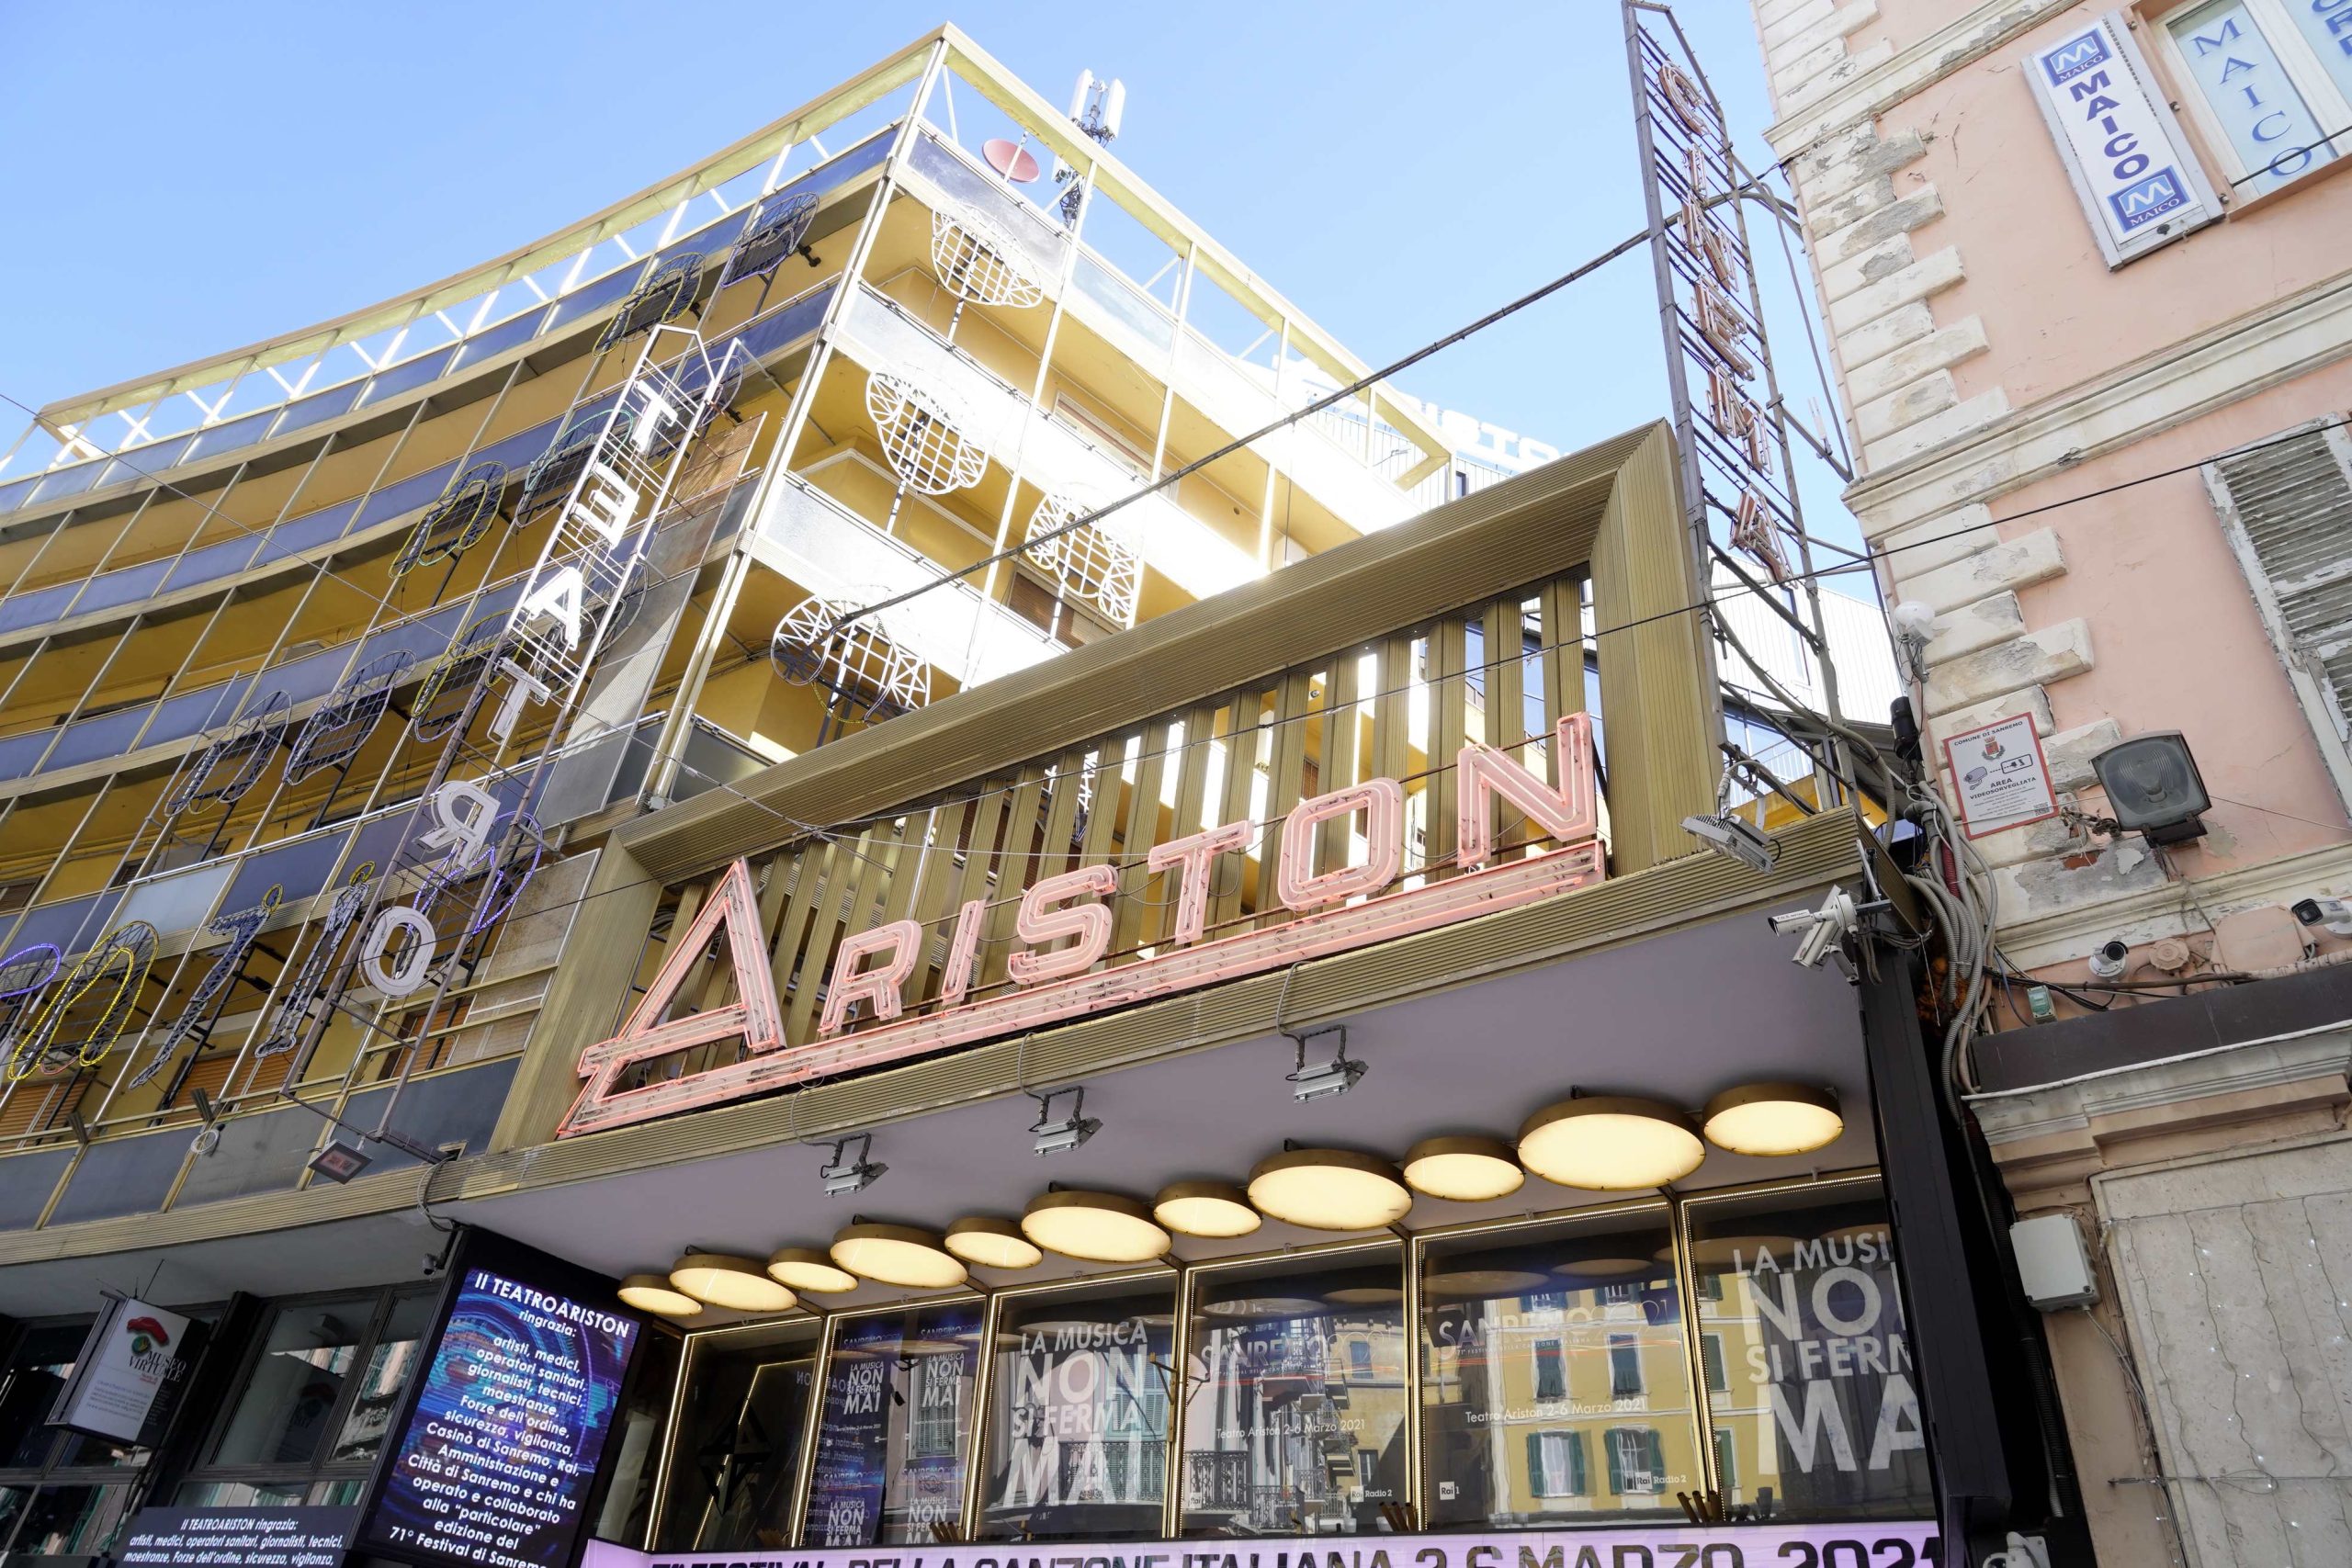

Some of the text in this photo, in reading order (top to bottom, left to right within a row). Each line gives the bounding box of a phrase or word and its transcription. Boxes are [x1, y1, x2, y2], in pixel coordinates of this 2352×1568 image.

[2058, 53, 2104, 83] MAICO
[2192, 16, 2312, 177] MAICO
[2069, 69, 2150, 180] MAICO
[2130, 197, 2180, 228] MAICO
[1657, 60, 1798, 589] CINEMA
[1954, 735, 1982, 747] COMUNE
[1992, 721, 2023, 734] SANREMO
[1970, 776, 2037, 800] VIDEOSORVEGLIATA
[1990, 778, 2013, 789] AREA
[558, 711, 1605, 1138] ARISTON
[1733, 1246, 1780, 1278] LA
[475, 1272, 630, 1338] Il TEATROARISTON
[518, 1310, 577, 1337] ringrazia:
[1021, 1320, 1148, 1355] LA MUSICA
[147, 1350, 187, 1372] MUSEO
[493, 1336, 581, 1373] artisti, medici,
[860, 1361, 884, 1370] MUSICA
[938, 1352, 965, 1361] MUSICA
[1746, 1345, 1783, 1384] SI
[128, 1356, 183, 1382] VIRTUALE
[476, 1349, 586, 1392] operatori sanitari,
[848, 1369, 883, 1386] NON
[925, 1376, 962, 1387] SI FERMA
[926, 1359, 965, 1379] NON
[1015, 1344, 1148, 1406] NON
[467, 1364, 584, 1408] giornalisti, tecnici,
[846, 1383, 881, 1395] SI FERMA
[922, 1383, 962, 1408] MAI
[482, 1385, 560, 1417] maestranze,
[843, 1392, 881, 1415] MAI
[1464, 1399, 1646, 1424] Teatro Ariston 2-6 Marzo 2021
[460, 1394, 570, 1438] Forze dell'ordine,
[1012, 1400, 1142, 1438] SI FERMA
[1216, 1419, 1365, 1439] Teatro Ariston 2-6 Marzo 2021
[445, 1410, 573, 1458] sicurezza, vigilanza,
[426, 1422, 580, 1477] Casinò di Sanremo, Rai,
[437, 1444, 560, 1487] Amministrazione e
[1002, 1430, 1142, 1507] MAI
[408, 1454, 577, 1511] Città di Sanremo e chi ha
[1364, 1489, 1387, 1497] Radio
[1441, 1486, 1454, 1496] Rai
[1637, 1475, 1652, 1486] Rai
[1654, 1474, 1680, 1484] Radio
[413, 1476, 560, 1524] operato e collaborato
[423, 1497, 449, 1514] alla
[840, 1500, 865, 1509] MUSICA
[910, 1496, 948, 1506] LA MUSICA
[188, 1518, 255, 1531] TEATROARISTON
[254, 1517, 299, 1535] ringrazia:
[828, 1507, 865, 1527] NON
[908, 1505, 948, 1523] NON
[434, 1520, 520, 1551] edizione del
[826, 1525, 862, 1536] SI FERMA
[907, 1523, 914, 1533] SI
[130, 1535, 343, 1550] artisti, medici, operatori sanitari, giornalisti, tecnici,
[416, 1533, 469, 1557] Festival
[472, 1548, 487, 1562] di
[489, 1551, 548, 1568] Sanrem
[124, 1551, 334, 1568] maestranze, Forze dell'ordine, sicurezza, vigilanza,
